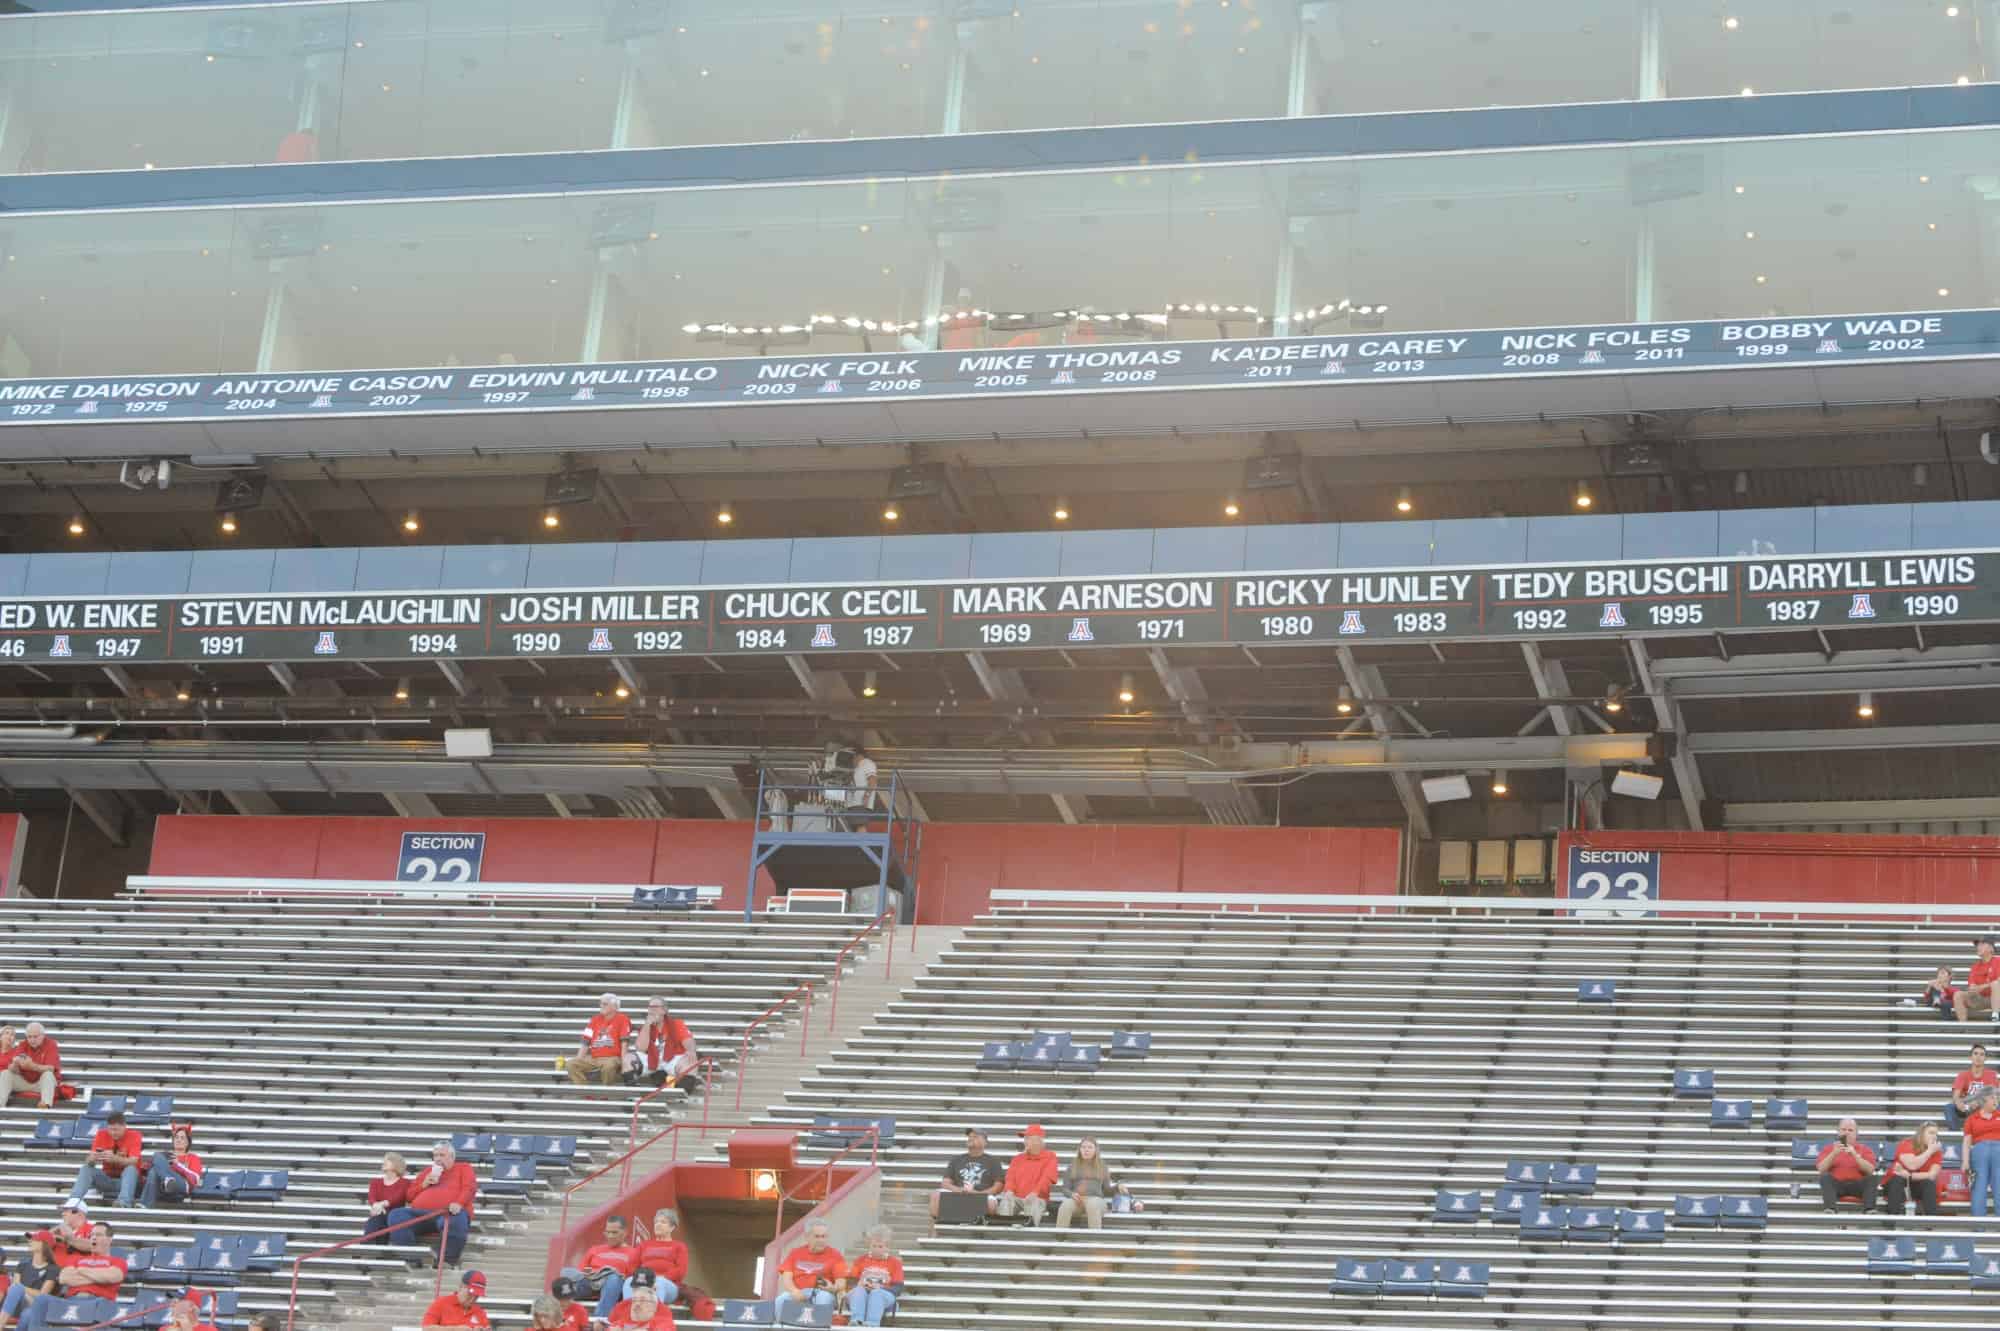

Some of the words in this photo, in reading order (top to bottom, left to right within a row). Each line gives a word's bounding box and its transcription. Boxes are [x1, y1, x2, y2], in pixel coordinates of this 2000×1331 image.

[1501, 333, 1577, 351] NICK
[1587, 328, 1691, 348] FOLES
[1722, 322, 1833, 341] BOBBY
[1844, 317, 1942, 337] WADE
[1209, 343, 1350, 363] KA'DEEM
[1358, 338, 1468, 357] CAREY
[1503, 352, 1561, 367] 2008
[1634, 347, 1684, 361] 2011
[1735, 343, 1789, 357] 1999
[1867, 338, 1925, 352] 2002
[757, 362, 832, 379] NICK
[838, 359, 919, 377] FOLK
[958, 354, 1036, 372] MIKE
[1045, 349, 1182, 369] THOMAS
[1243, 364, 1293, 378] 2011
[1372, 359, 1425, 373] 2013
[212, 377, 343, 396] ANTOINE
[348, 375, 454, 392] CASON
[467, 371, 566, 389] EDWIN
[570, 366, 718, 385] MULITALO
[743, 382, 797, 396] 2003
[866, 378, 922, 392] 2006
[973, 374, 1029, 388] 2005
[1100, 369, 1158, 383] 2008
[0, 384, 70, 400] MIKE
[71, 382, 201, 399] DAWSON
[223, 398, 277, 411] 2004
[368, 393, 422, 407] 2007
[483, 391, 530, 403] 1997
[641, 386, 690, 399] 1998
[11, 403, 56, 416] 1972
[125, 401, 169, 413] 1975
[1491, 571, 1575, 600] TEDY
[1585, 565, 1728, 597] BRUSCHI
[1748, 561, 1877, 591] DARRYLL
[1884, 556, 1975, 587] LEWIS
[952, 586, 1047, 614] MARK
[1057, 581, 1213, 611] ARNESON
[1235, 578, 1332, 607] RICKY
[1342, 574, 1472, 604] HUNLEY
[180, 600, 293, 626] STEVEN
[299, 597, 481, 625] McLAUGHLIN
[500, 596, 583, 623] JOSH
[591, 594, 700, 621] MILLER
[725, 591, 832, 619] CHUCK
[841, 589, 927, 616] CECIL
[1766, 599, 1821, 621] 1987
[1848, 594, 1875, 618] A
[1903, 594, 1959, 616] 1990
[0, 604, 36, 629] ED
[45, 604, 76, 628] W.
[83, 603, 158, 628] ENKE
[1260, 615, 1313, 636] 1980
[1339, 611, 1365, 634] A
[1393, 612, 1447, 633] 1983
[1513, 608, 1567, 630] 1992
[1600, 603, 1625, 626] A
[1648, 603, 1703, 625] 1995
[512, 632, 561, 652] 1990
[588, 628, 612, 652] A
[633, 631, 683, 650] 1992
[735, 628, 787, 649] 1984
[812, 624, 836, 648] A
[863, 625, 914, 646] 1987
[979, 623, 1032, 644] 1969
[1069, 618, 1094, 642] A
[1137, 618, 1184, 640] 1971
[49, 635, 73, 656] A
[95, 638, 141, 657] 1947
[199, 636, 244, 655] 1991
[314, 632, 337, 655] A
[409, 633, 458, 653] 1994
[410, 837, 475, 850] SECTION
[1579, 850, 1649, 864] SECTION
[1576, 871, 1648, 917] 23
